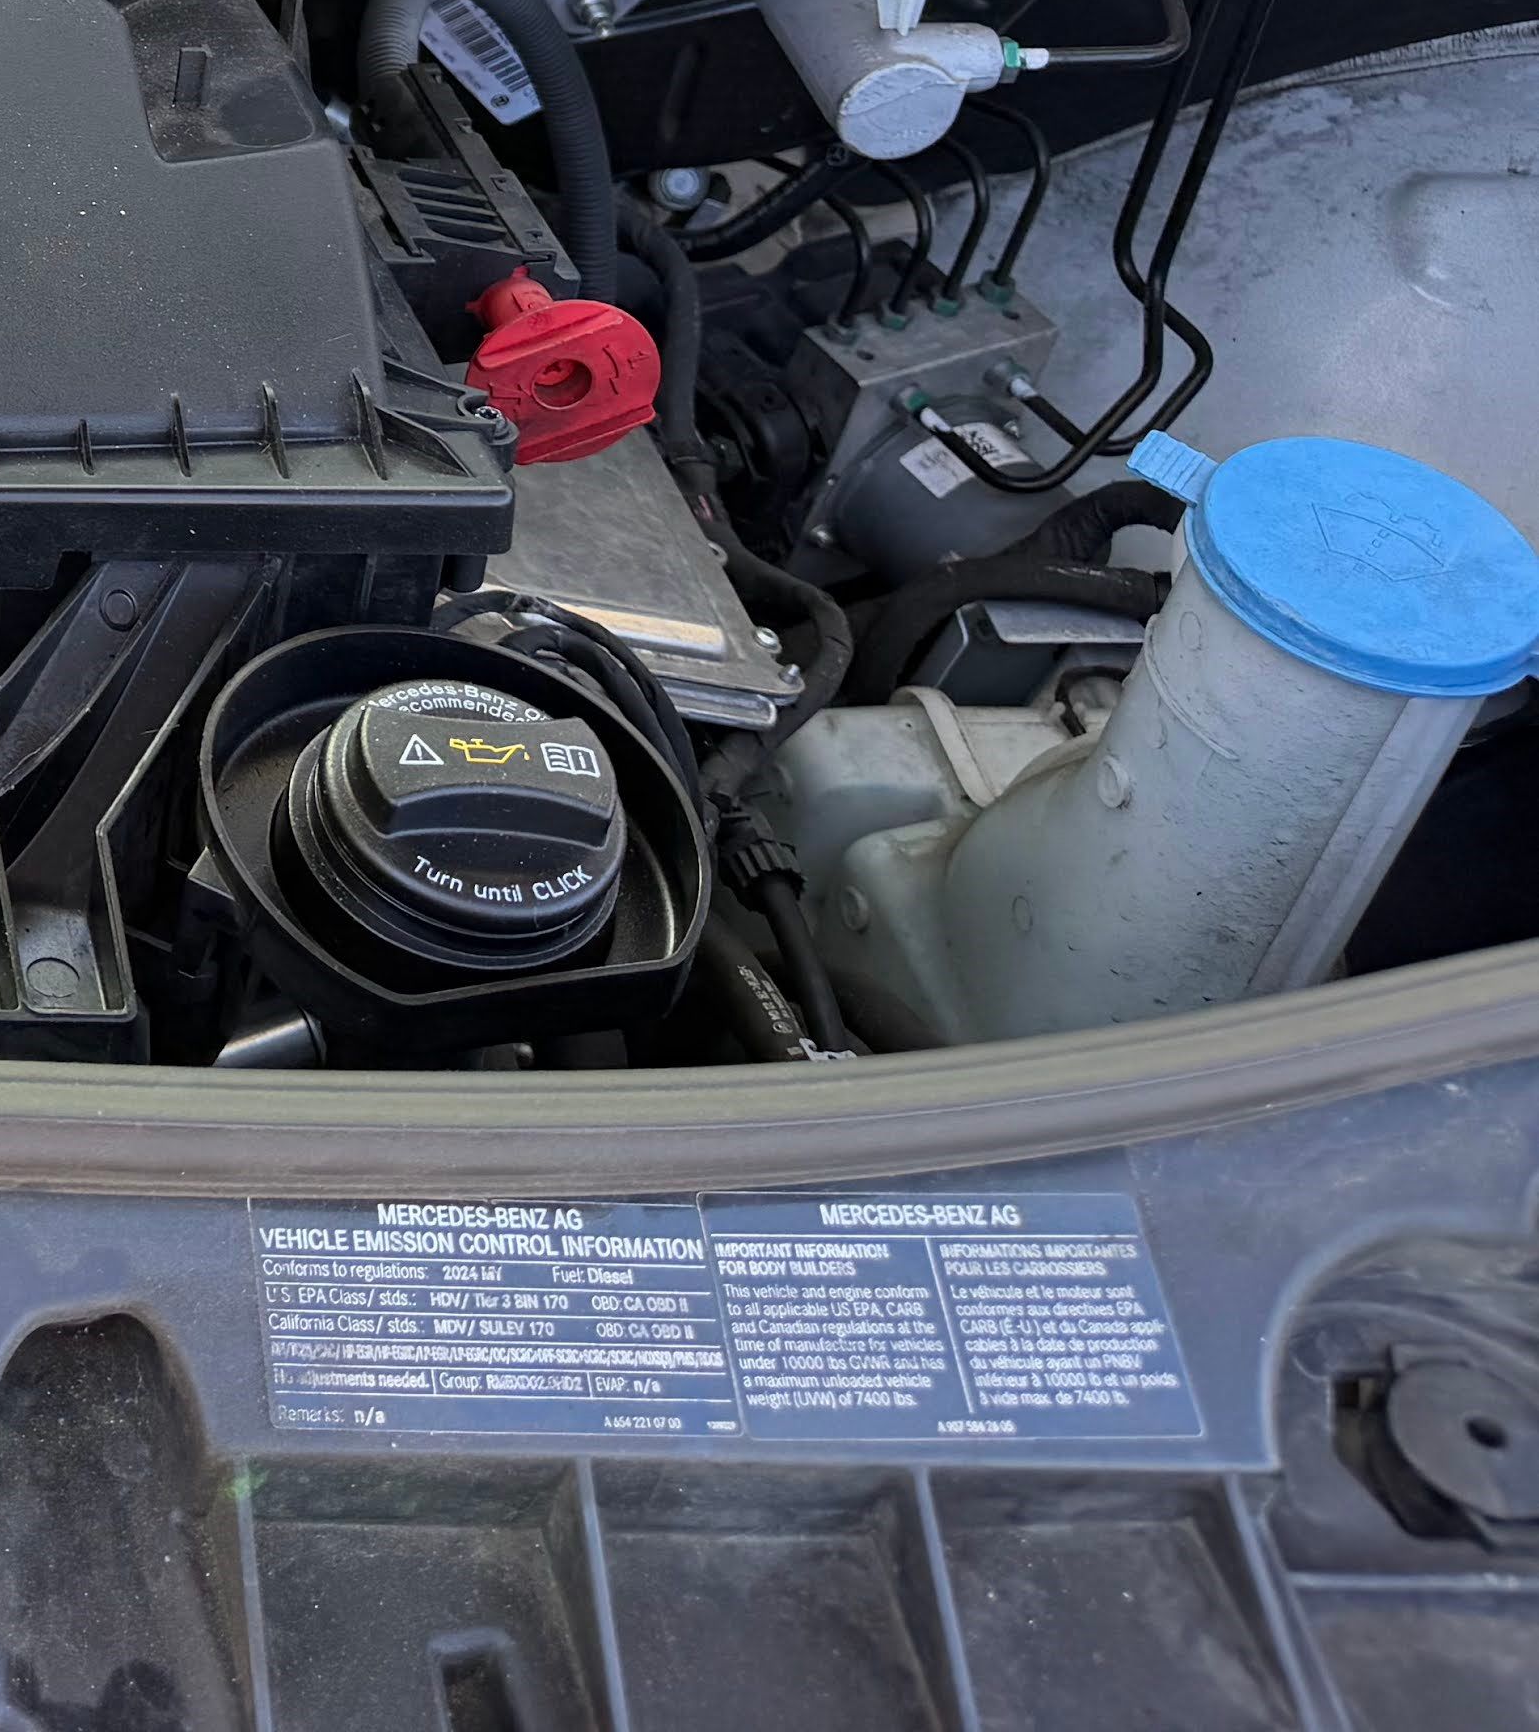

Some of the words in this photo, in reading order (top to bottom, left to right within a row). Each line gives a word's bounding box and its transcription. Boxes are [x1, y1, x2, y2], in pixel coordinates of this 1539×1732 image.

[414, 856, 463, 892] Turn
[474, 884, 522, 902] until
[532, 865, 593, 900] CLICK
[377, 1203, 551, 1229] MERCEDES-BENZ
[553, 1209, 583, 1230] AG
[819, 1204, 987, 1225] MERCEDES-BENZ
[991, 1205, 1020, 1225] AG
[259, 1228, 349, 1250] VEHICLE
[352, 1230, 454, 1254] EMISSION
[459, 1232, 559, 1256] CONTROL
[561, 1235, 704, 1260] INFORMATION
[714, 1243, 792, 1257] IMPORTANT
[794, 1243, 890, 1259] INFORMATION
[941, 1244, 1042, 1259] INFORMATIONS
[1045, 1244, 1136, 1259] IMPORTANTES
[263, 1259, 330, 1277] Conforms
[332, 1261, 348, 1277] to
[350, 1262, 429, 1282] regulations:
[442, 1265, 478, 1281] 2024
[552, 1265, 585, 1283] Fuel:
[587, 1267, 634, 1285] Diesel
[718, 1260, 746, 1276] FOR
[749, 1260, 786, 1276] BODY
[789, 1261, 856, 1276] BUILDERS
[945, 1261, 984, 1276] POUR
[987, 1261, 1010, 1276] LES
[1013, 1261, 1106, 1276] CARROSSIERS
[298, 1288, 326, 1304] EPA
[473, 1292, 498, 1307] Tier
[514, 1294, 539, 1308] BIN
[543, 1294, 568, 1309] 170
[623, 1296, 646, 1312] CA
[646, 1297, 676, 1313] OBD
[722, 1284, 750, 1298] This
[753, 1285, 797, 1299] vehicle
[802, 1285, 826, 1299] and
[829, 1286, 872, 1302] engine
[875, 1285, 928, 1299] conform
[727, 1303, 741, 1316] to
[744, 1302, 760, 1316] all
[763, 1303, 829, 1318] applicable
[831, 1302, 850, 1316] US
[886, 1302, 924, 1317] CARB
[268, 1314, 334, 1331] California
[479, 1319, 524, 1336] SULEV
[530, 1321, 555, 1337] 170
[628, 1323, 649, 1339] CA
[651, 1324, 680, 1340] OBD
[731, 1321, 756, 1334] and
[758, 1320, 821, 1334] Canadian
[823, 1321, 895, 1337] regulations
[898, 1322, 911, 1334] at
[914, 1321, 936, 1334] the
[734, 1338, 764, 1351] time
[767, 1338, 781, 1351] of
[784, 1338, 866, 1352] manufacture
[868, 1338, 886, 1352] for
[890, 1339, 943, 1351] vehicles
[738, 1356, 776, 1369] under
[782, 1356, 825, 1369] 10000
[828, 1356, 845, 1369] lbs
[849, 1356, 890, 1369] GVWR
[893, 1356, 918, 1369] and
[921, 1357, 945, 1370] has
[379, 1372, 430, 1388] needed.
[439, 1372, 481, 1392] Group:
[633, 1378, 661, 1394] n/a
[755, 1375, 819, 1388] maximum
[822, 1375, 883, 1388] unloaded
[886, 1375, 931, 1388] vehicle
[746, 1391, 790, 1407] weight
[793, 1391, 835, 1407] (UVW)
[839, 1391, 852, 1405] of
[854, 1392, 890, 1405] 7400
[278, 1405, 345, 1423] Remarks:
[354, 1407, 386, 1426] n/a
[614, 1417, 631, 1428] 654
[634, 1417, 651, 1428] 221
